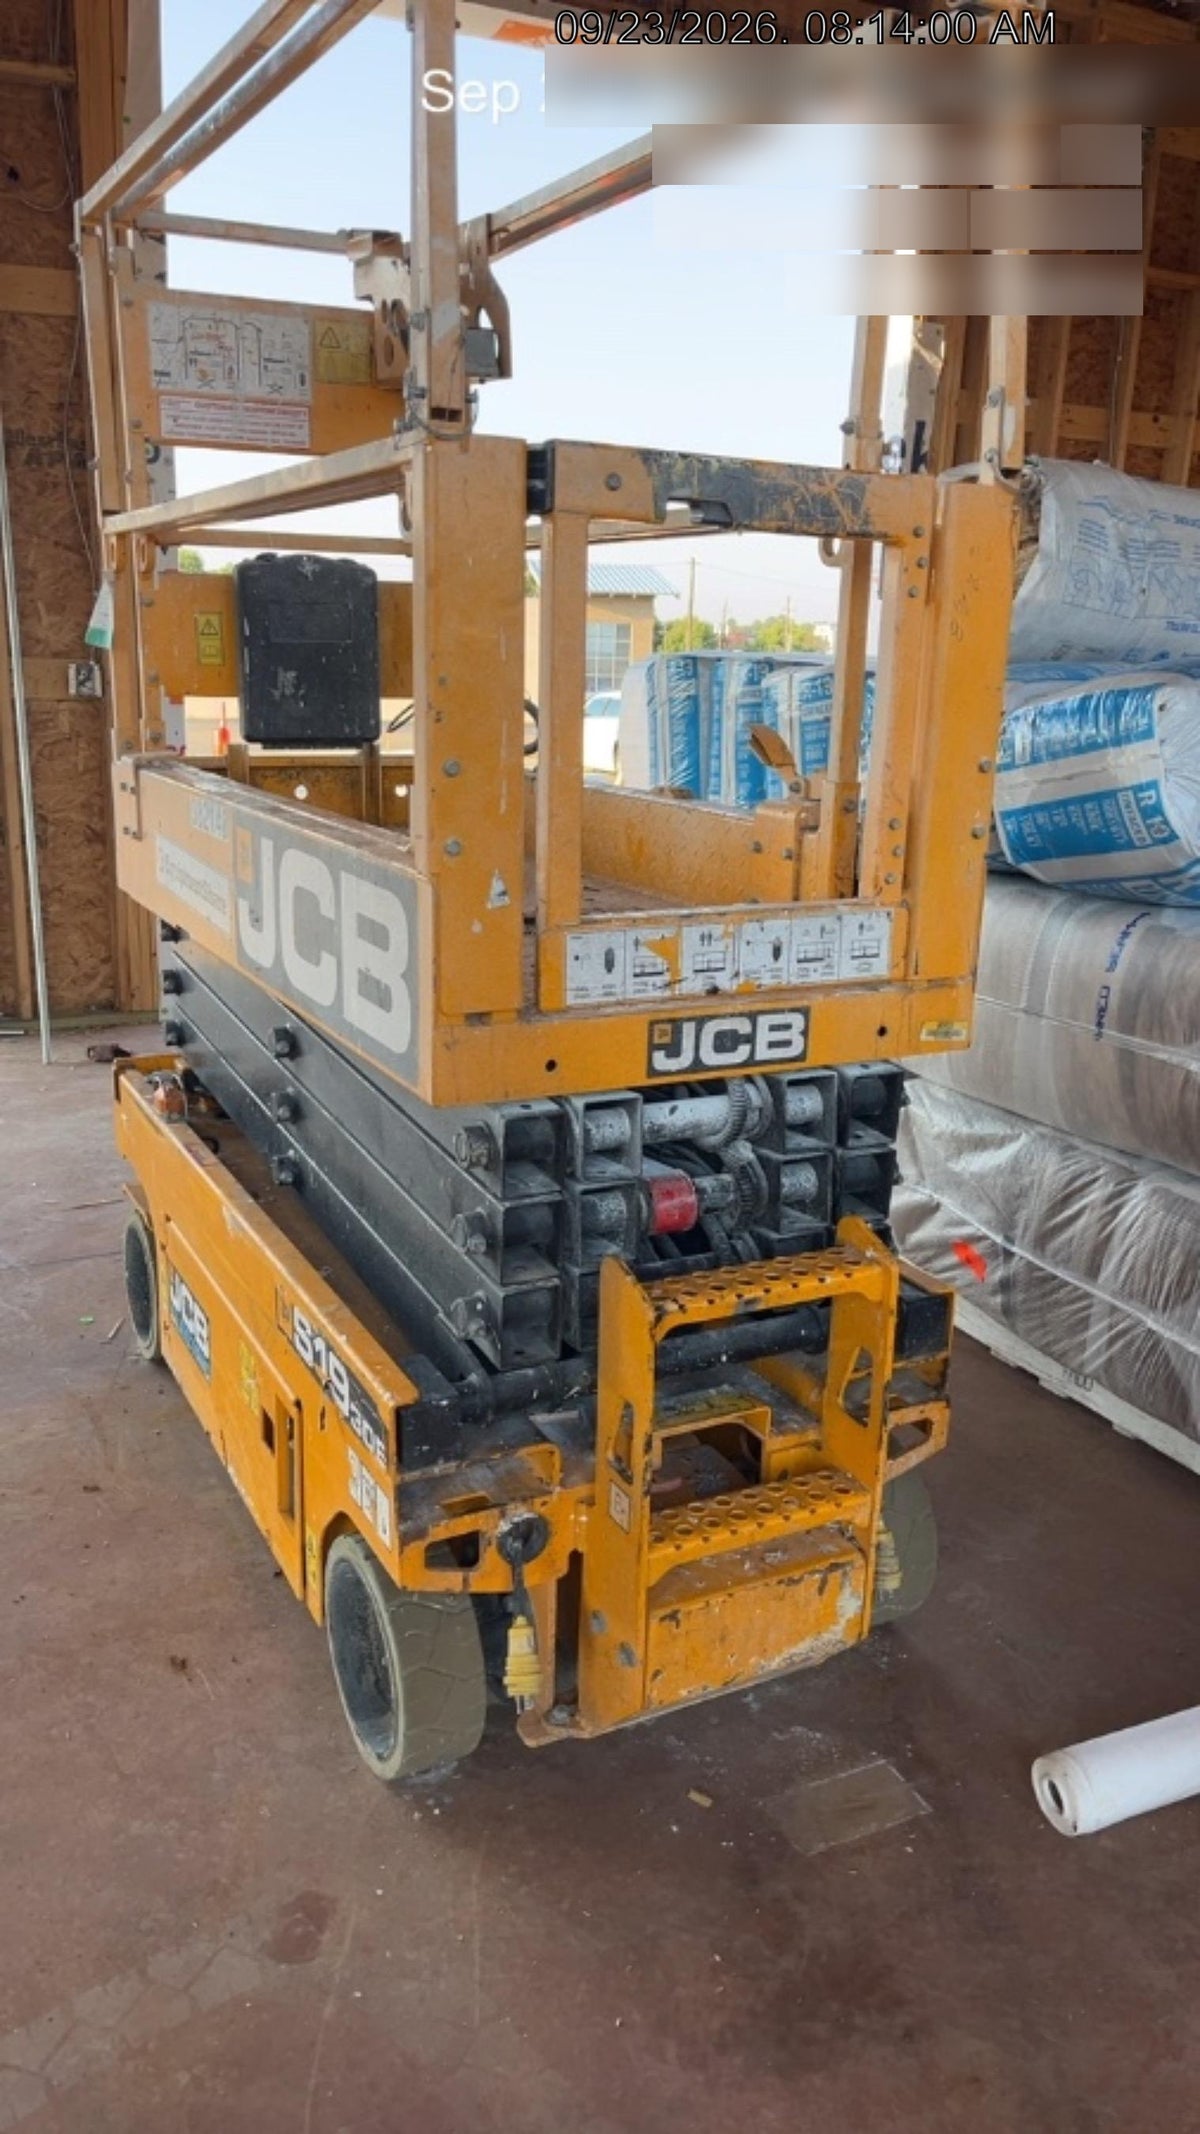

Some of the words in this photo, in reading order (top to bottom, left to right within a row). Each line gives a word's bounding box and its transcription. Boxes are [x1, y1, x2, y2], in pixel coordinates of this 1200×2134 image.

[237, 838, 411, 1053] JCB
[652, 1011, 805, 1071] JCB
[170, 1271, 210, 1359] JCB
